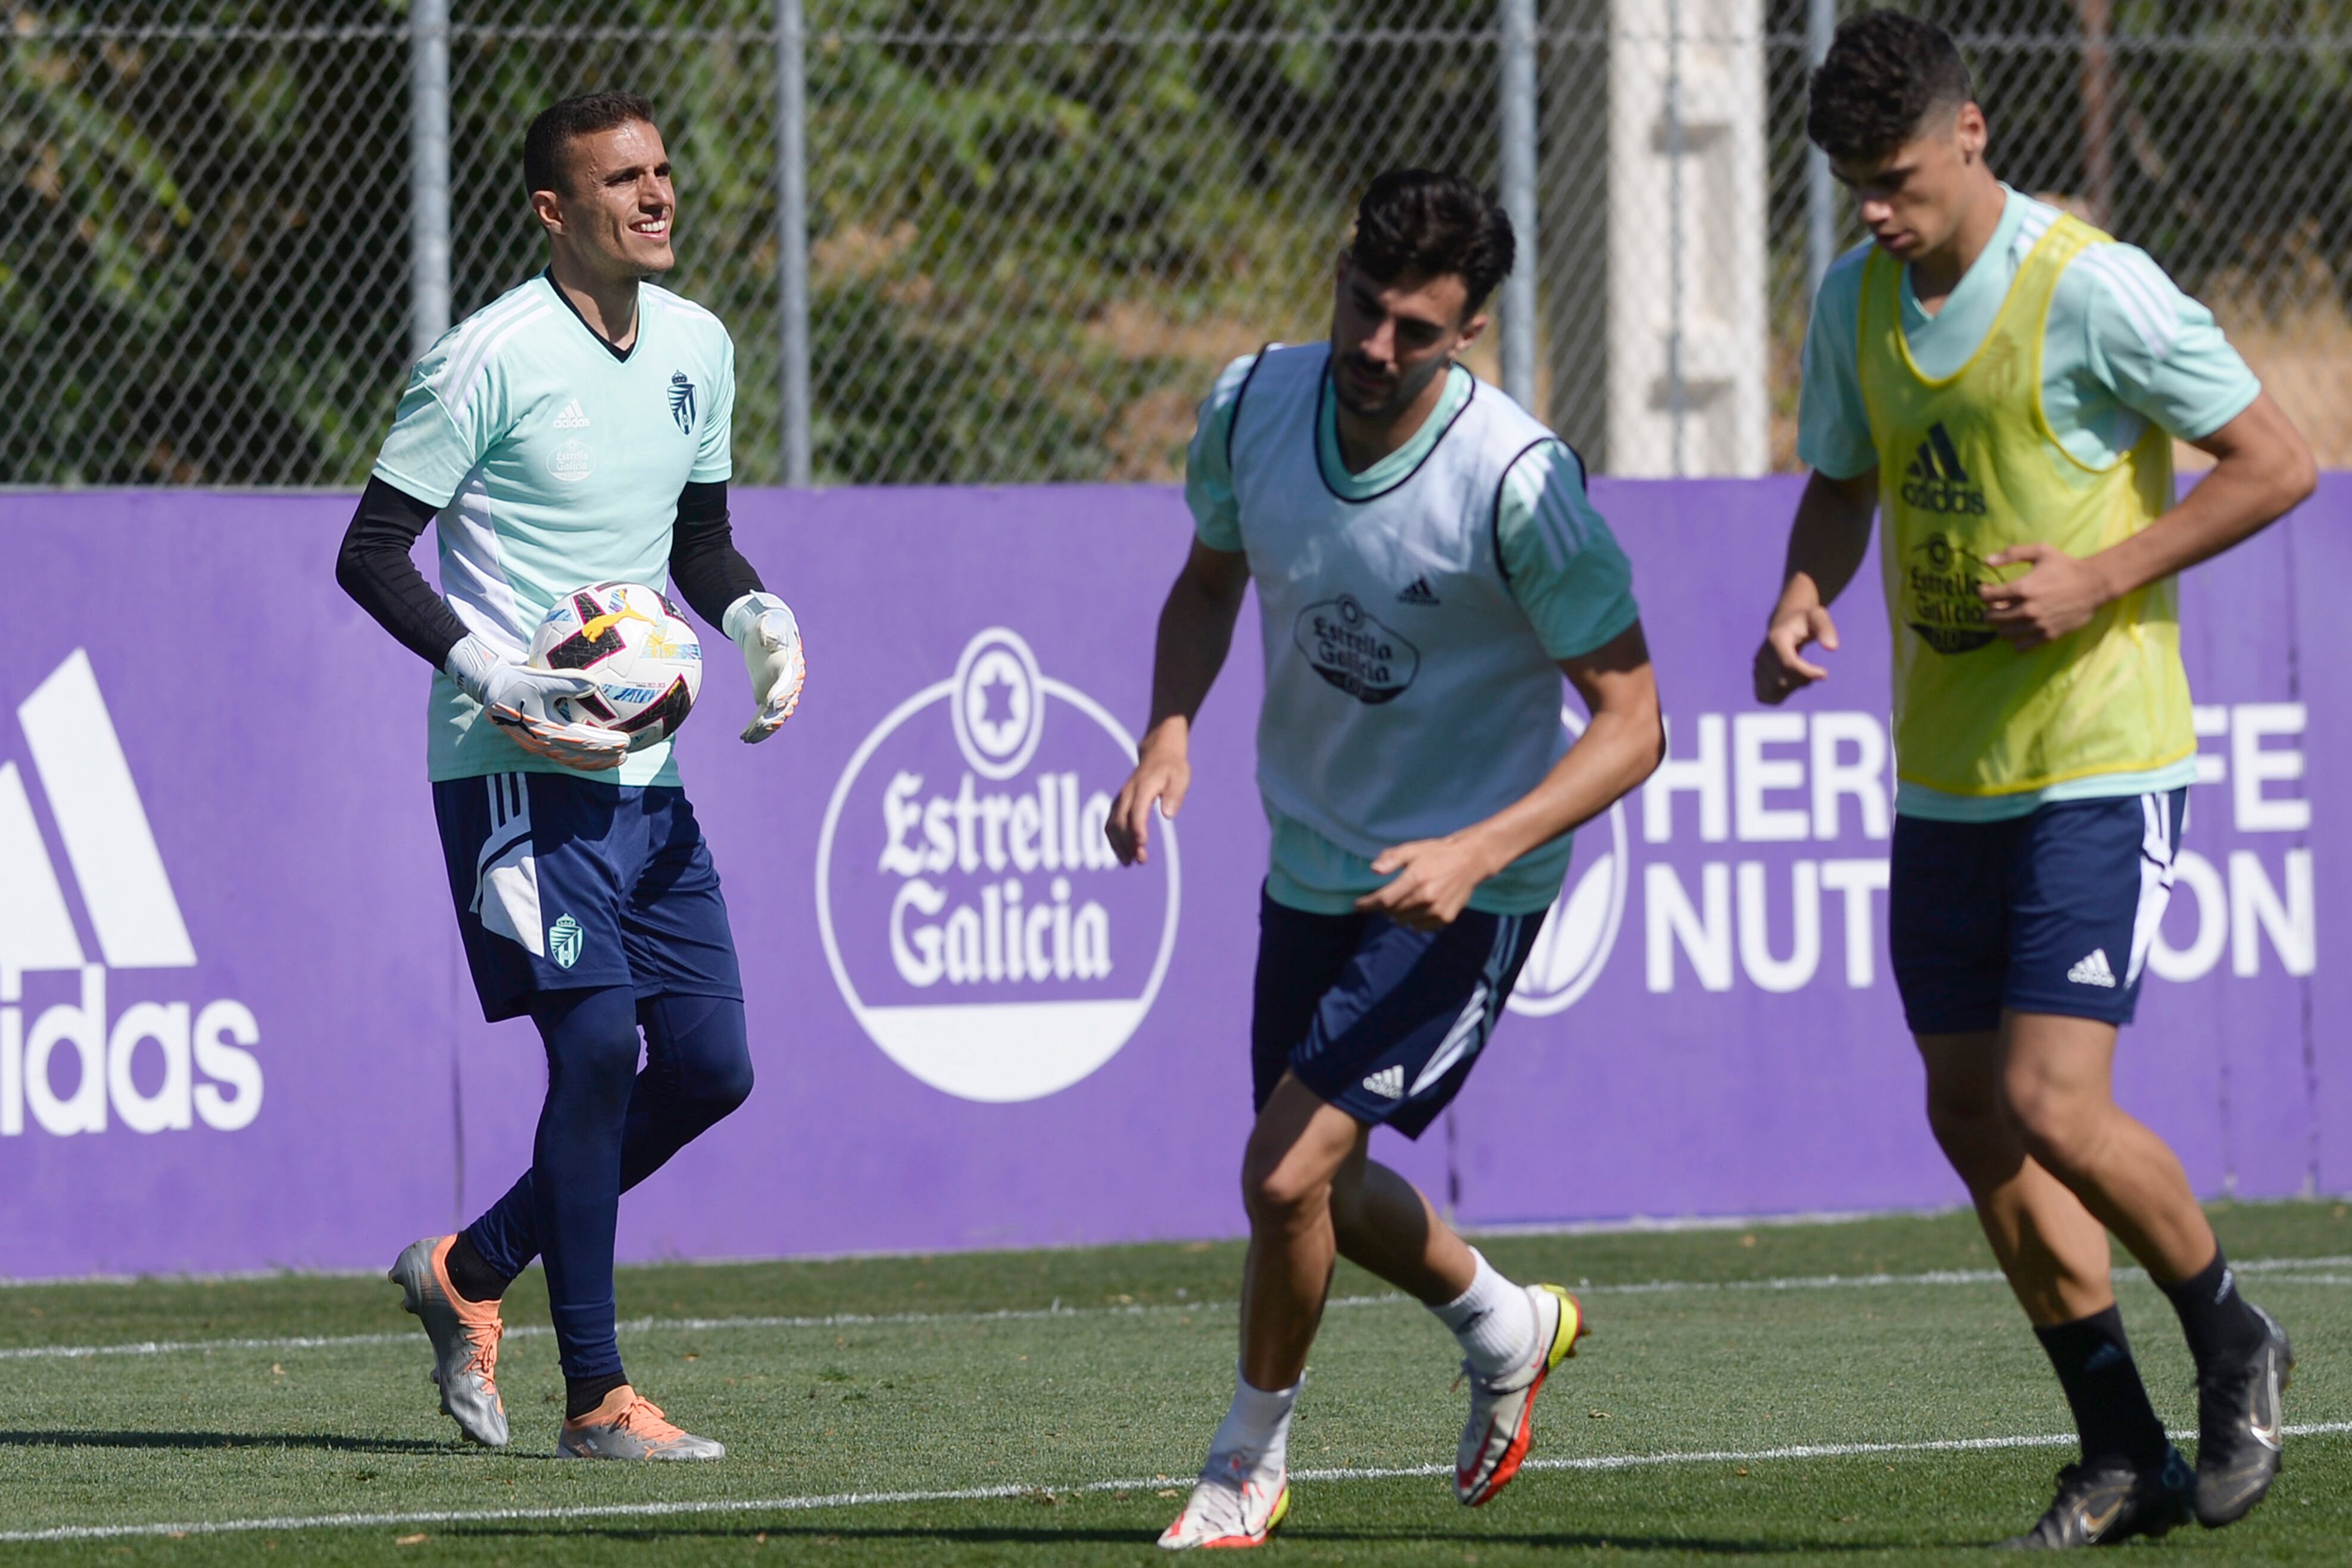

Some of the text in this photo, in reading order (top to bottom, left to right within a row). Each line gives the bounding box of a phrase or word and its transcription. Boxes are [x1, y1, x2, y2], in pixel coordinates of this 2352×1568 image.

[553, 417, 590, 429] adidas
[1901, 478, 1986, 516] adidas
[879, 769, 1120, 877] Estrella
[889, 876, 1113, 988] Galicia
